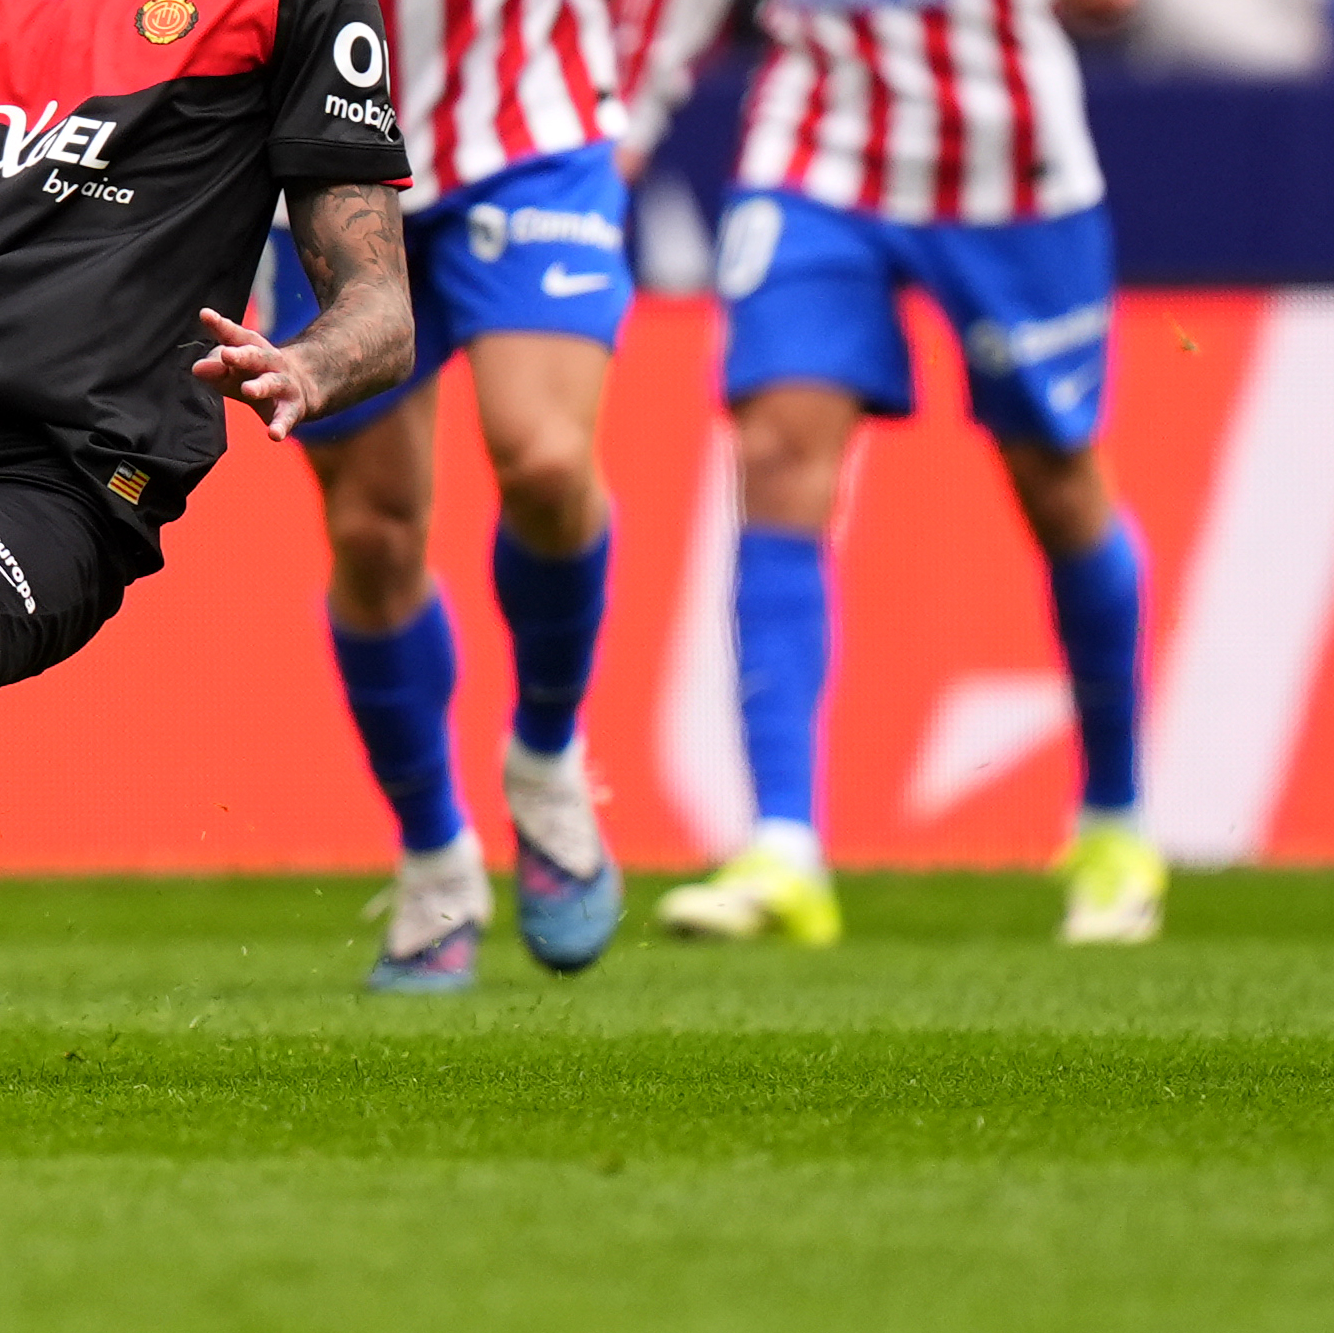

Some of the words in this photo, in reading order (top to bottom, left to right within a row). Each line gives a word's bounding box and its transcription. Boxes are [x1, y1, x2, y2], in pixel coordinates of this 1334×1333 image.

[333, 21, 391, 98] O
[324, 94, 397, 143] mobili
[42, 168, 79, 203] by
